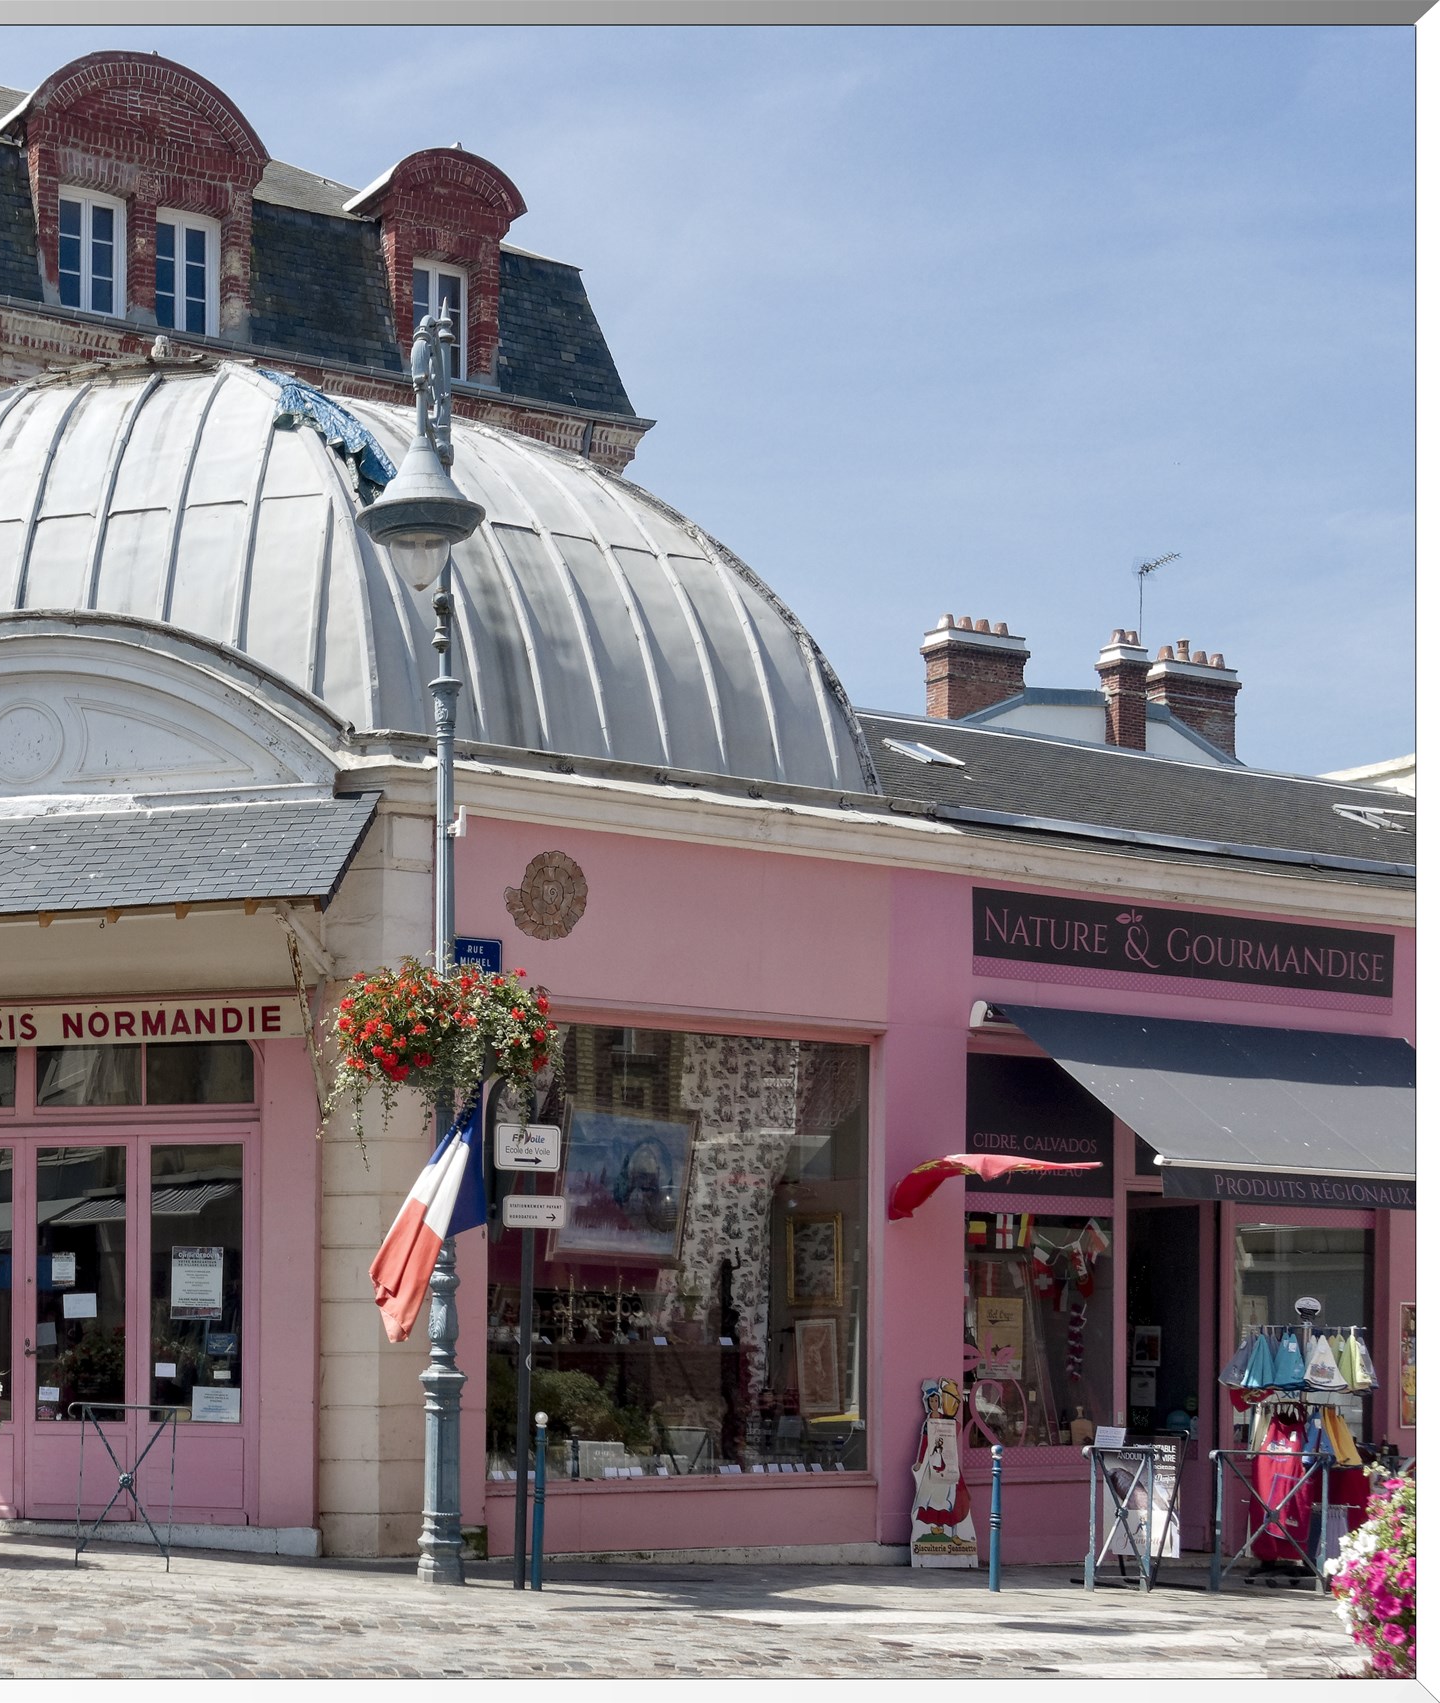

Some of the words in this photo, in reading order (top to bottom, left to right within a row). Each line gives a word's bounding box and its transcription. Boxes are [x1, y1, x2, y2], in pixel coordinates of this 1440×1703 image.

[467, 945, 484, 954] RUE
[984, 905, 1108, 954] NATURE
[1124, 921, 1160, 968] &
[1167, 927, 1385, 983] GOURMANDISE
[460, 957, 491, 967] MICHEL
[62, 1005, 281, 1039] NORMANDIE
[973, 1133, 1020, 1150] CIDRE,
[1023, 1136, 1097, 1154] CALVADOS
[524, 1147, 533, 1155] de
[534, 1147, 551, 1156] Voile
[1214, 1174, 1306, 1199] PRODUITS
[913, 1544, 946, 1554] Biscuiterie
[947, 1544, 977, 1554] Jeannette
